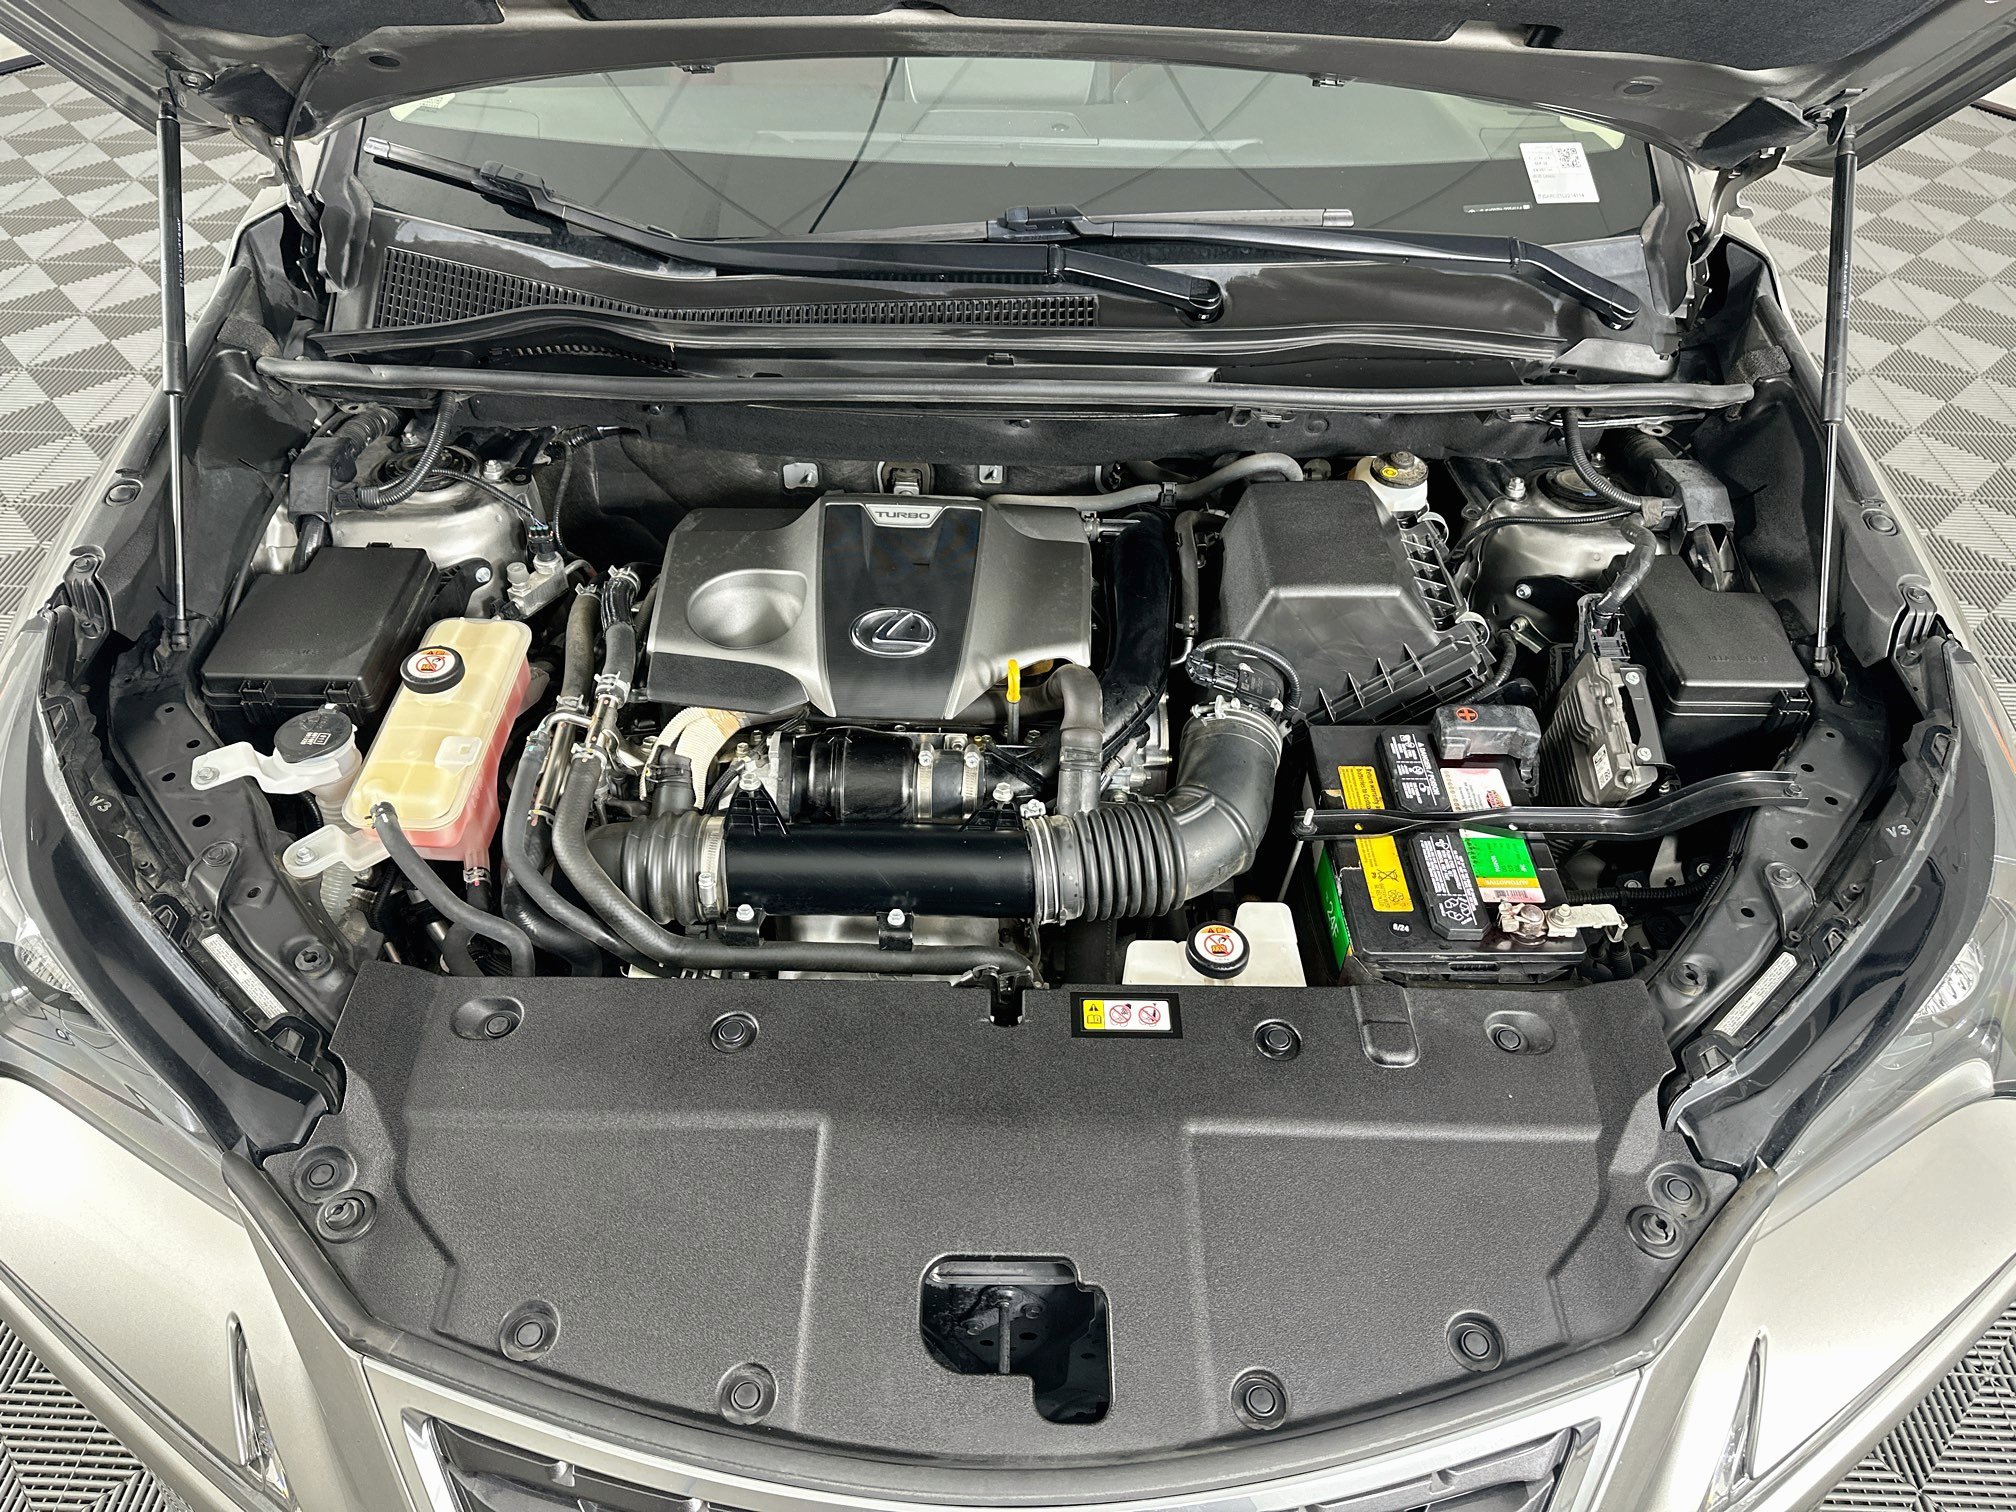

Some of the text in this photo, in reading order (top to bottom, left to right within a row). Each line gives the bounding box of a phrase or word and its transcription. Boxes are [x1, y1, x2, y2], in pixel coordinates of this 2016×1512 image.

[875, 511, 931, 520] TURBO
[1420, 747, 1432, 769] DANGER
[1427, 774, 1441, 796] POISON
[89, 795, 112, 812] V3
[1885, 824, 1911, 838] V3
